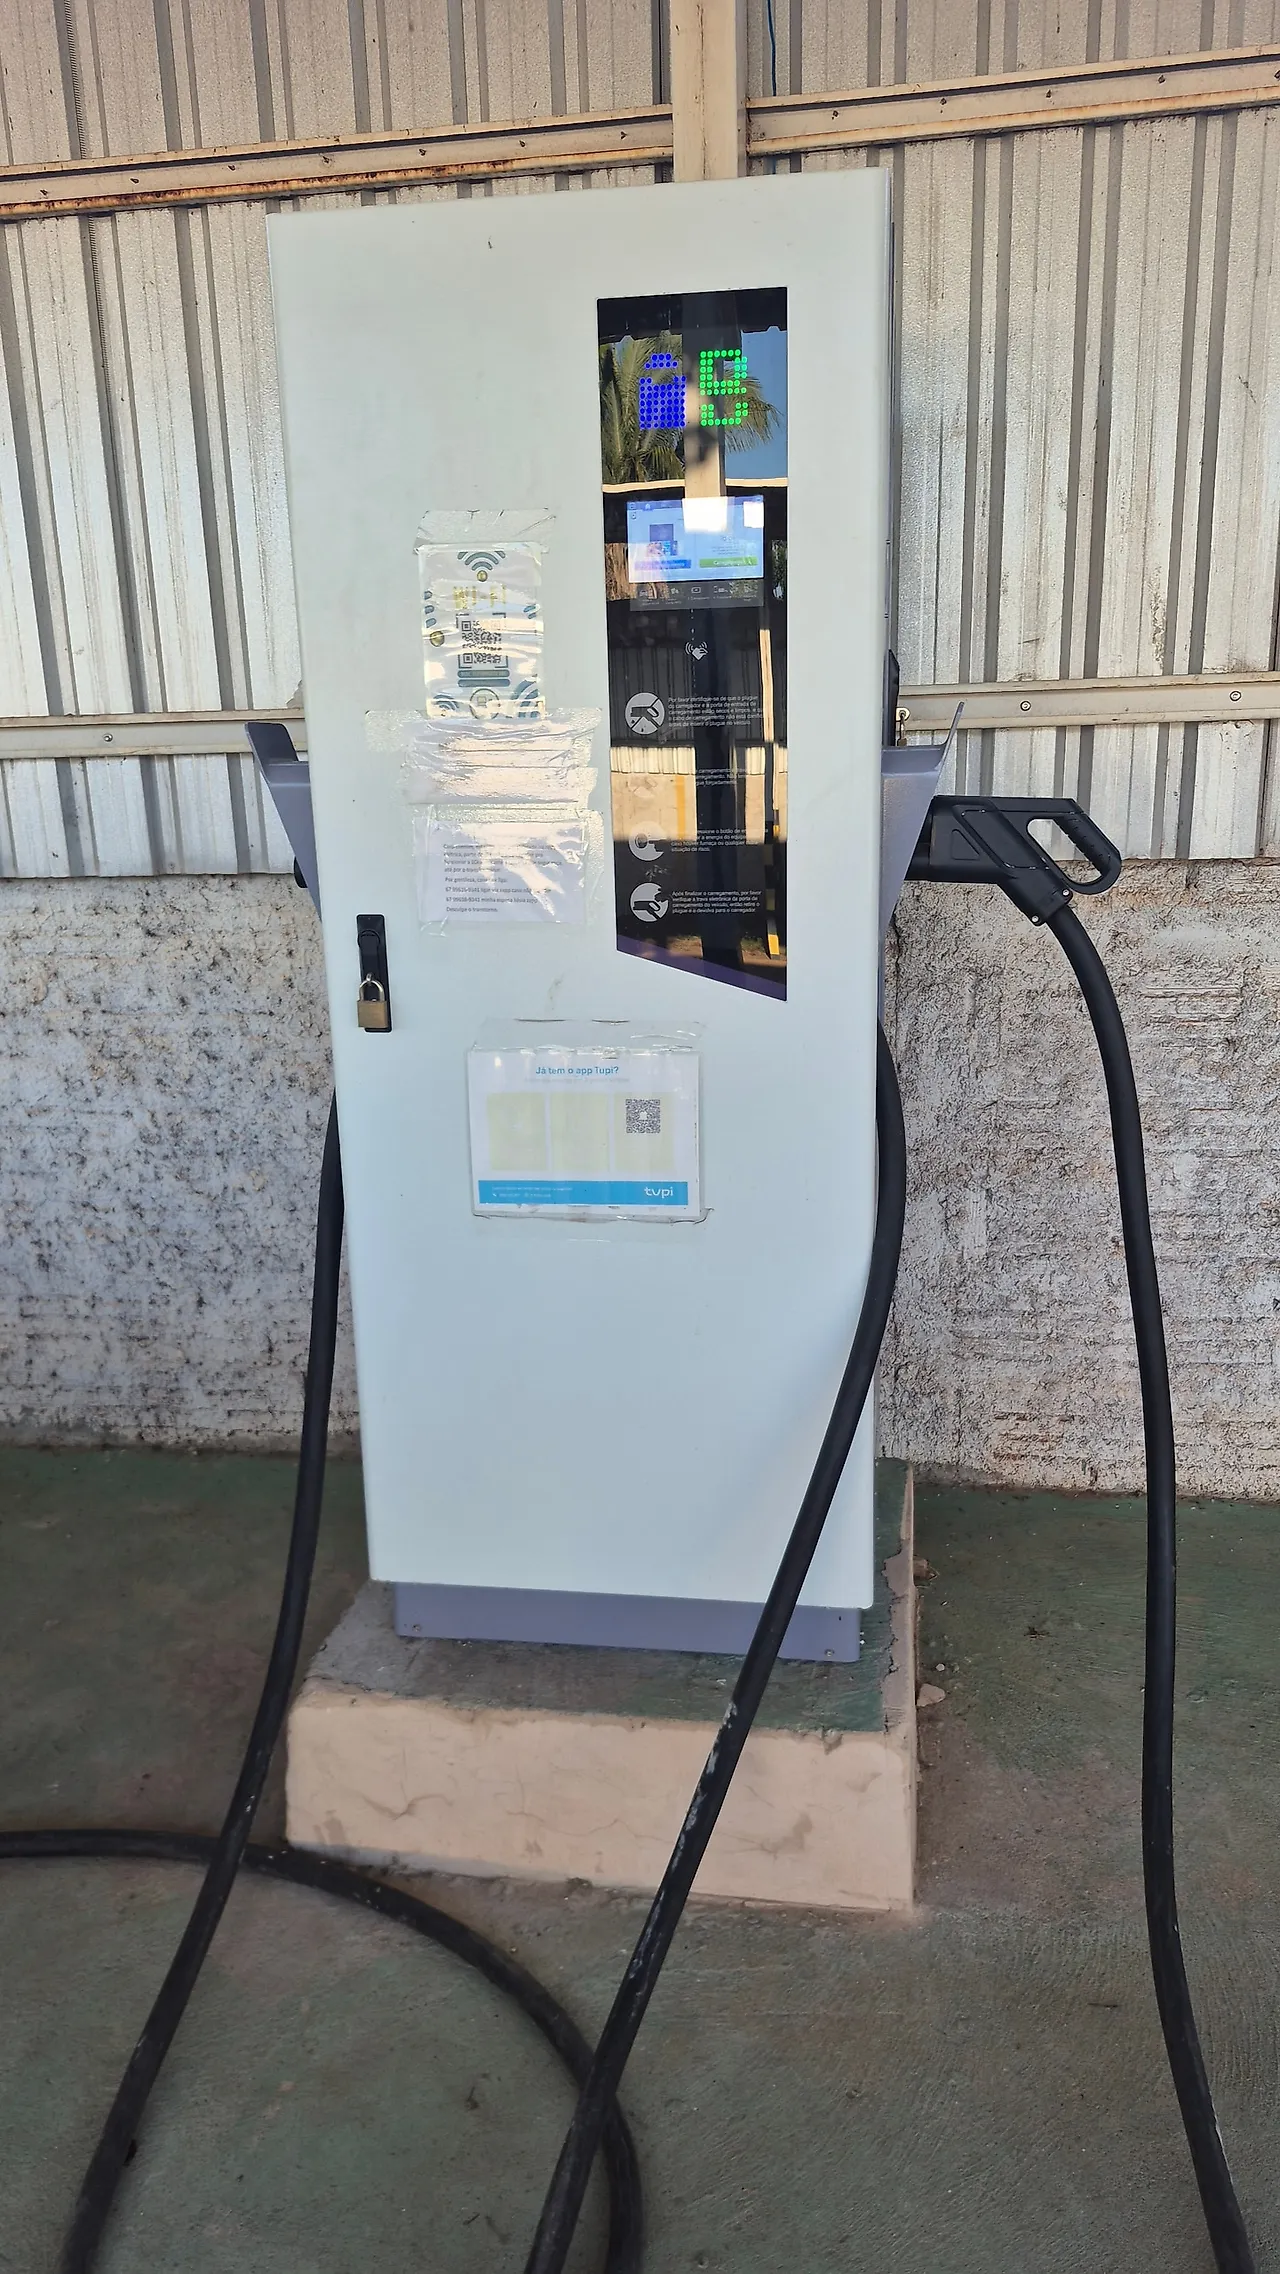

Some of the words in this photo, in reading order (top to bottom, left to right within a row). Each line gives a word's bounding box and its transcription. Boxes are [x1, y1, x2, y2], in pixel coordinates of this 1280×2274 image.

[700, 349, 748, 426] B
[536, 1066, 546, 1074] Já
[575, 1068, 592, 1076] app
